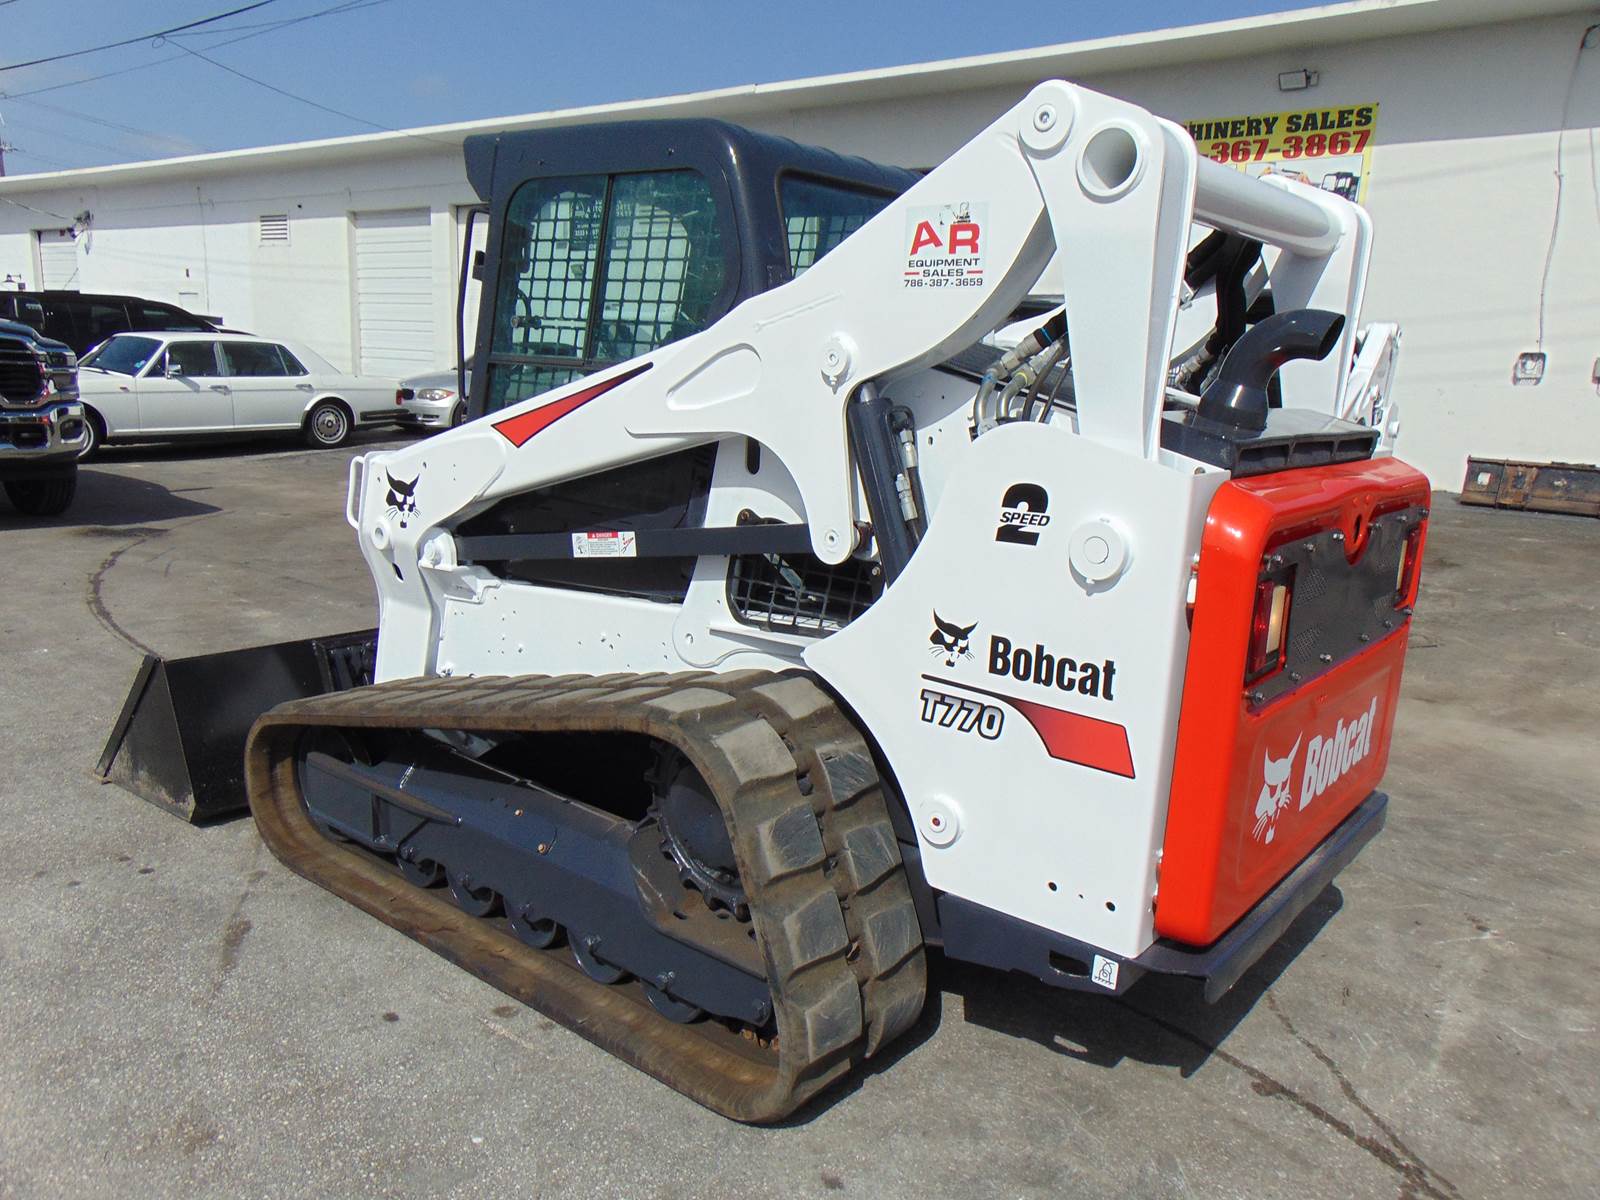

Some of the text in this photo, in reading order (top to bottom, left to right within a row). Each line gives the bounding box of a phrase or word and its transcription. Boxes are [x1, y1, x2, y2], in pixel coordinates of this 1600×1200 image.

[1187, 107, 1373, 141] HINERY SALES
[910, 220, 980, 256] AR
[908, 258, 980, 268] EQUIPMENT
[922, 268, 964, 278] SALES
[995, 482, 1049, 547] 2
[999, 511, 1051, 527] SPEED
[988, 634, 1116, 701] Bobcat
[920, 688, 1005, 740] T770
[1298, 695, 1378, 812] Bobcat
